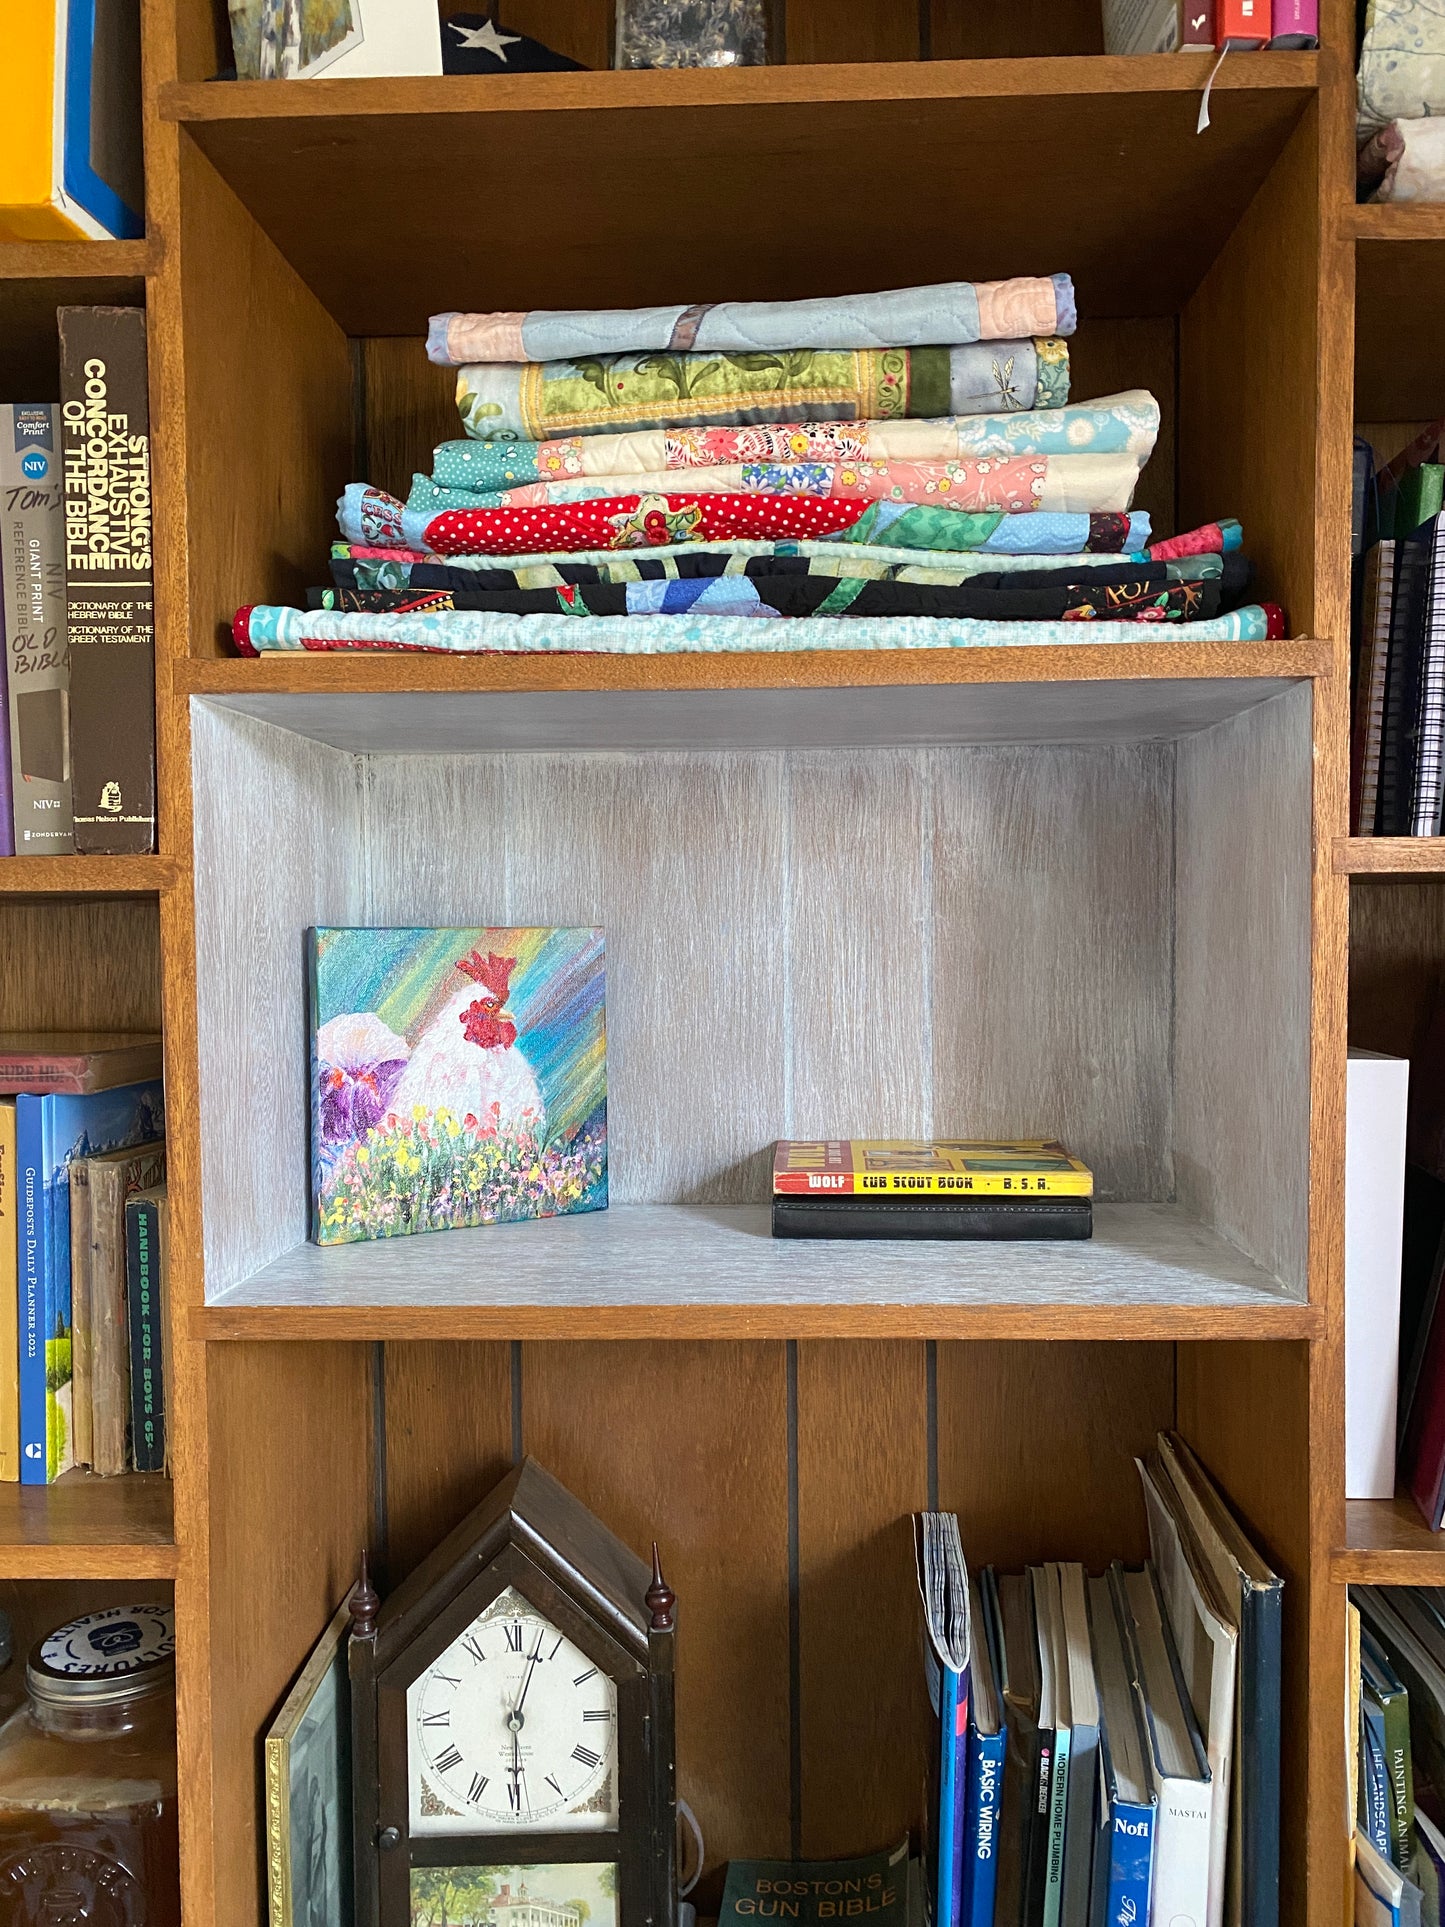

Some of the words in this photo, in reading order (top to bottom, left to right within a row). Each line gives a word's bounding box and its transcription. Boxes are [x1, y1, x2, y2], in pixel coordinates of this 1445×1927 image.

[16, 421, 50, 430] Comfort
[62, 400, 86, 437] OF
[24, 461, 46, 471] NIV
[64, 443, 87, 494] THE
[83, 358, 110, 571] CONCORDANCE
[107, 413, 131, 570] EXHAUSTIVE
[128, 434, 152, 570] STRONG'S
[65, 500, 89, 570] BIBLE
[13, 521, 26, 599] REFERENCE
[29, 539, 42, 579] GIANT
[46, 563, 63, 599] NIV
[31, 583, 43, 623] PRINT
[67, 601, 119, 610] DICTIONARY
[121, 601, 134, 610] OF
[136, 601, 153, 610] THE
[67, 611, 107, 619] HEBREW
[108, 611, 133, 619] BIBLE
[13, 627, 57, 653] OLD
[67, 626, 119, 634] DICTIONARY
[121, 626, 134, 634] OF
[136, 625, 153, 634] THE
[67, 635, 98, 643] GREEK
[100, 635, 151, 643] TESTAMENT
[33, 800, 53, 809] NIV
[808, 1175, 845, 1188] WOLF
[863, 1176, 887, 1188] CUB
[893, 1176, 932, 1189] SCOUT
[938, 1177, 973, 1189] BOOK
[25, 1167, 36, 1236] GUIDEPOSTS
[27, 1239, 37, 1274] DAILY
[138, 1213, 150, 1316] HANDBOOK
[27, 1277, 38, 1329] PLANNER
[28, 1331, 36, 1358] 2022
[142, 1324, 152, 1360] FOR
[143, 1368, 153, 1414] BOYS
[46, 1609, 121, 1643] HEALTH
[130, 1605, 171, 1617] FOR
[980, 1758, 996, 1802] BASIC
[1055, 1752, 1066, 1796] MODERN
[1394, 1748, 1407, 1814] PAINTING
[1053, 1799, 1063, 1829] HOME
[1114, 1818, 1149, 1837] Nofi
[1168, 1808, 1208, 1820] MASTAI
[977, 1805, 994, 1860] WIRING
[1050, 1831, 1062, 1883] PLUMBING
[734, 1898, 800, 1918] GUN
[817, 1887, 897, 1918] BIBLE
[756, 1873, 883, 1896] BOSTON'S
